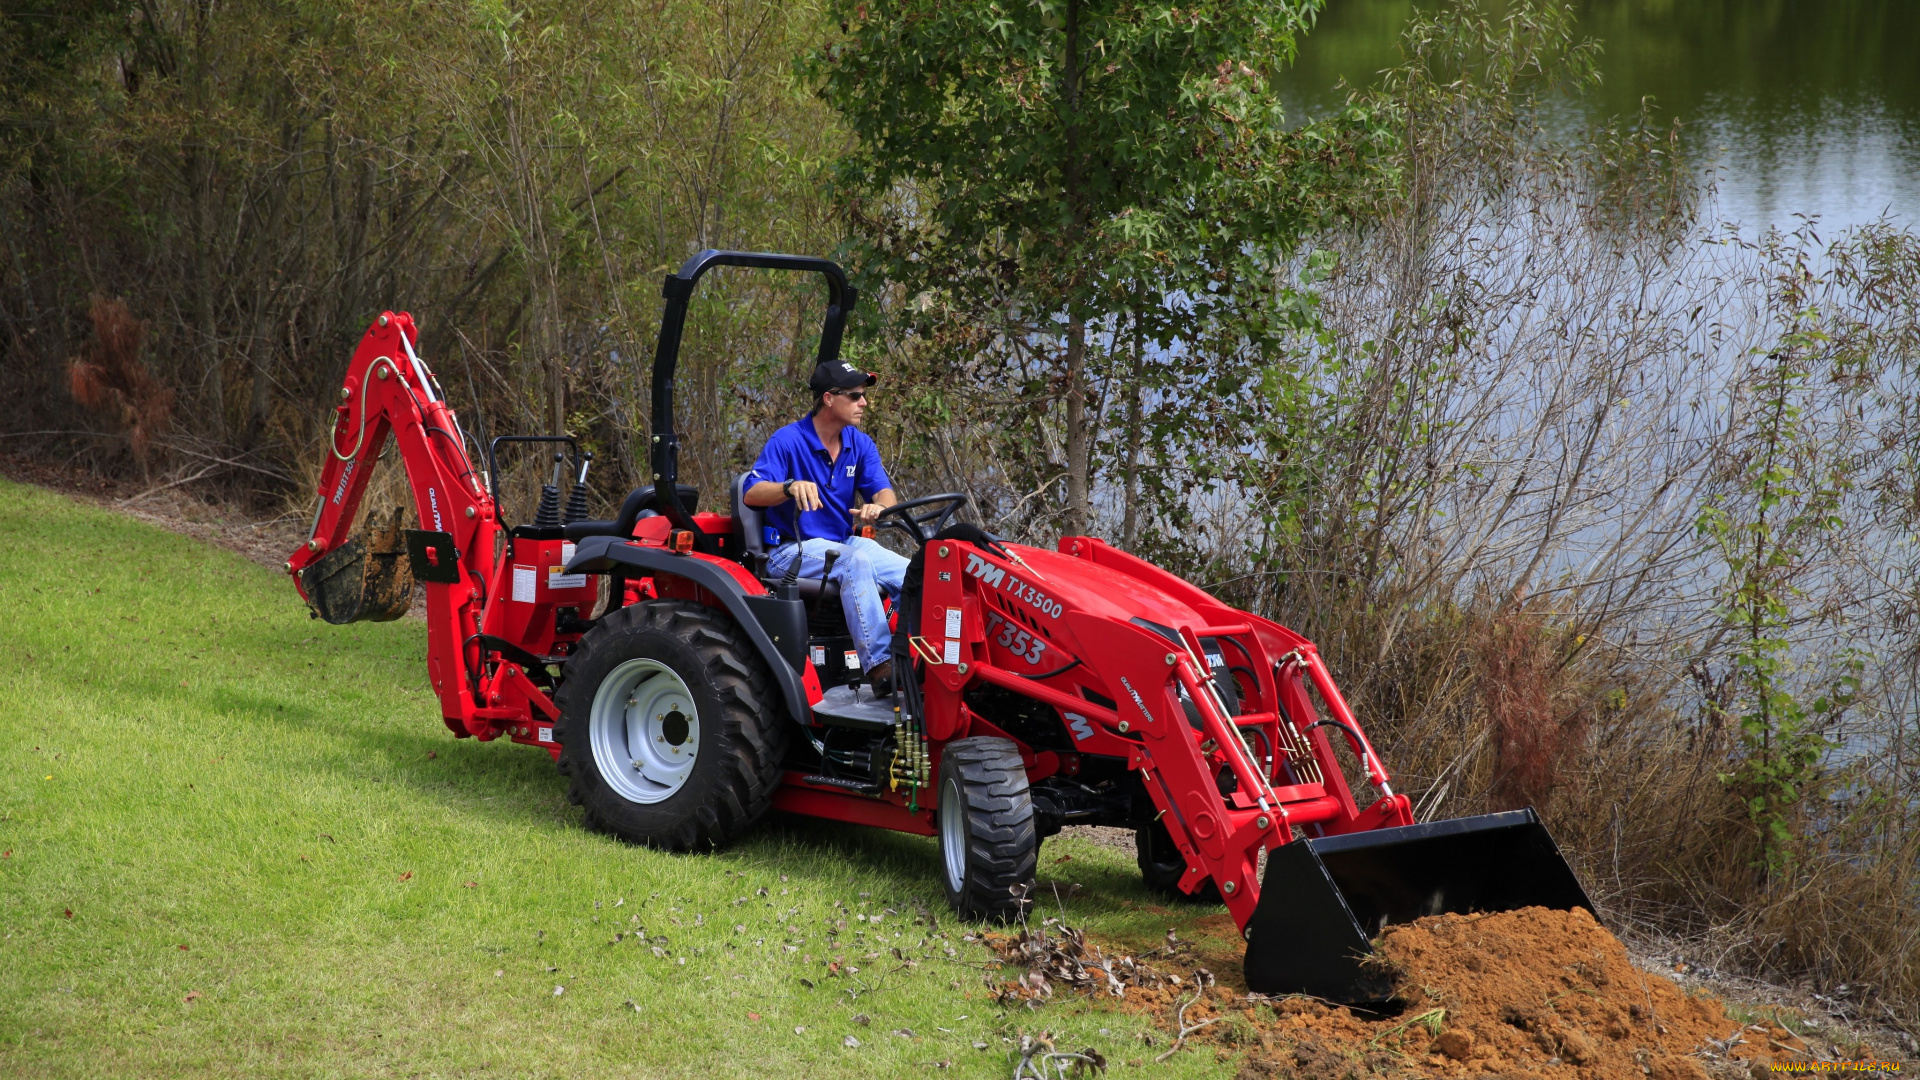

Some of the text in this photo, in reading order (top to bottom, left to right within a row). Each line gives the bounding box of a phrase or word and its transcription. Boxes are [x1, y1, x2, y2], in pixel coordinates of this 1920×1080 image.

[332, 485, 345, 505] TYM
[965, 552, 1063, 619] TYM TX3500
[985, 610, 1046, 665] T353
